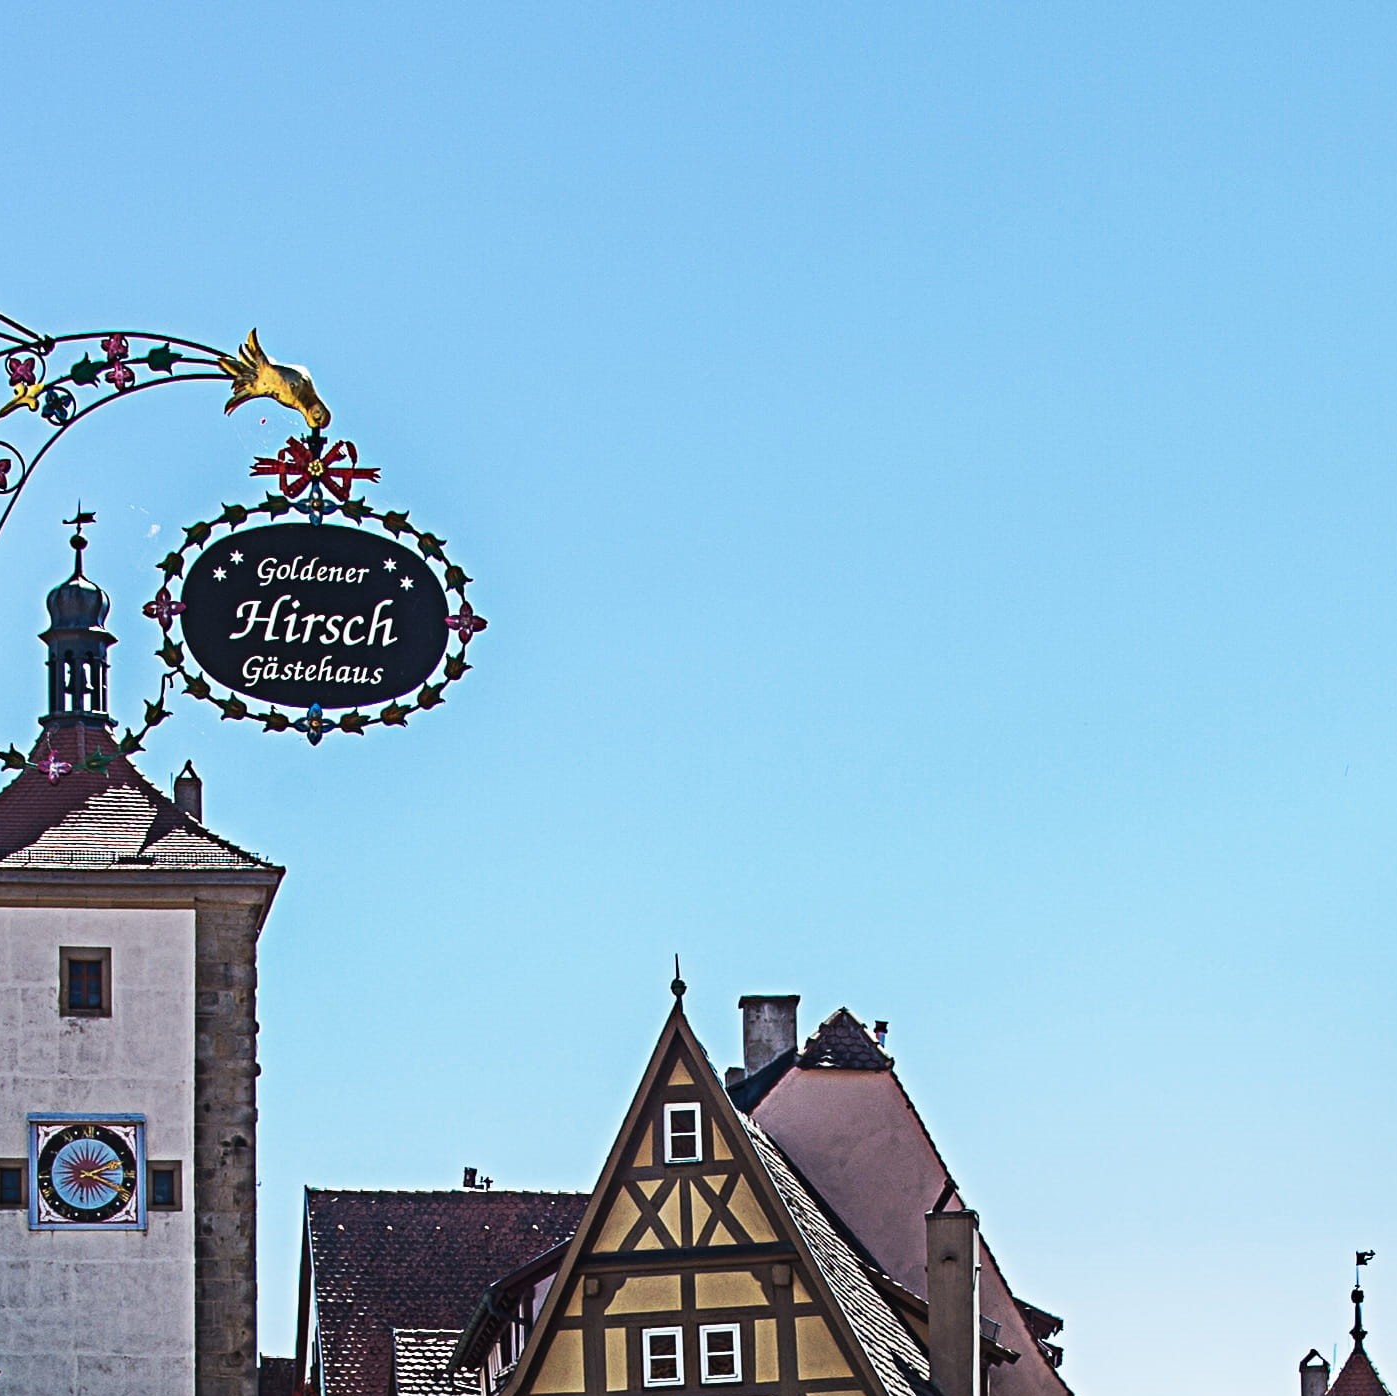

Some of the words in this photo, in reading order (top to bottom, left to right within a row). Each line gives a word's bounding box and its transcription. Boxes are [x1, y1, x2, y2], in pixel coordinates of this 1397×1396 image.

[257, 555, 370, 587] Goldener
[228, 594, 399, 648] Hirsch
[242, 655, 385, 688] Gästehaus
